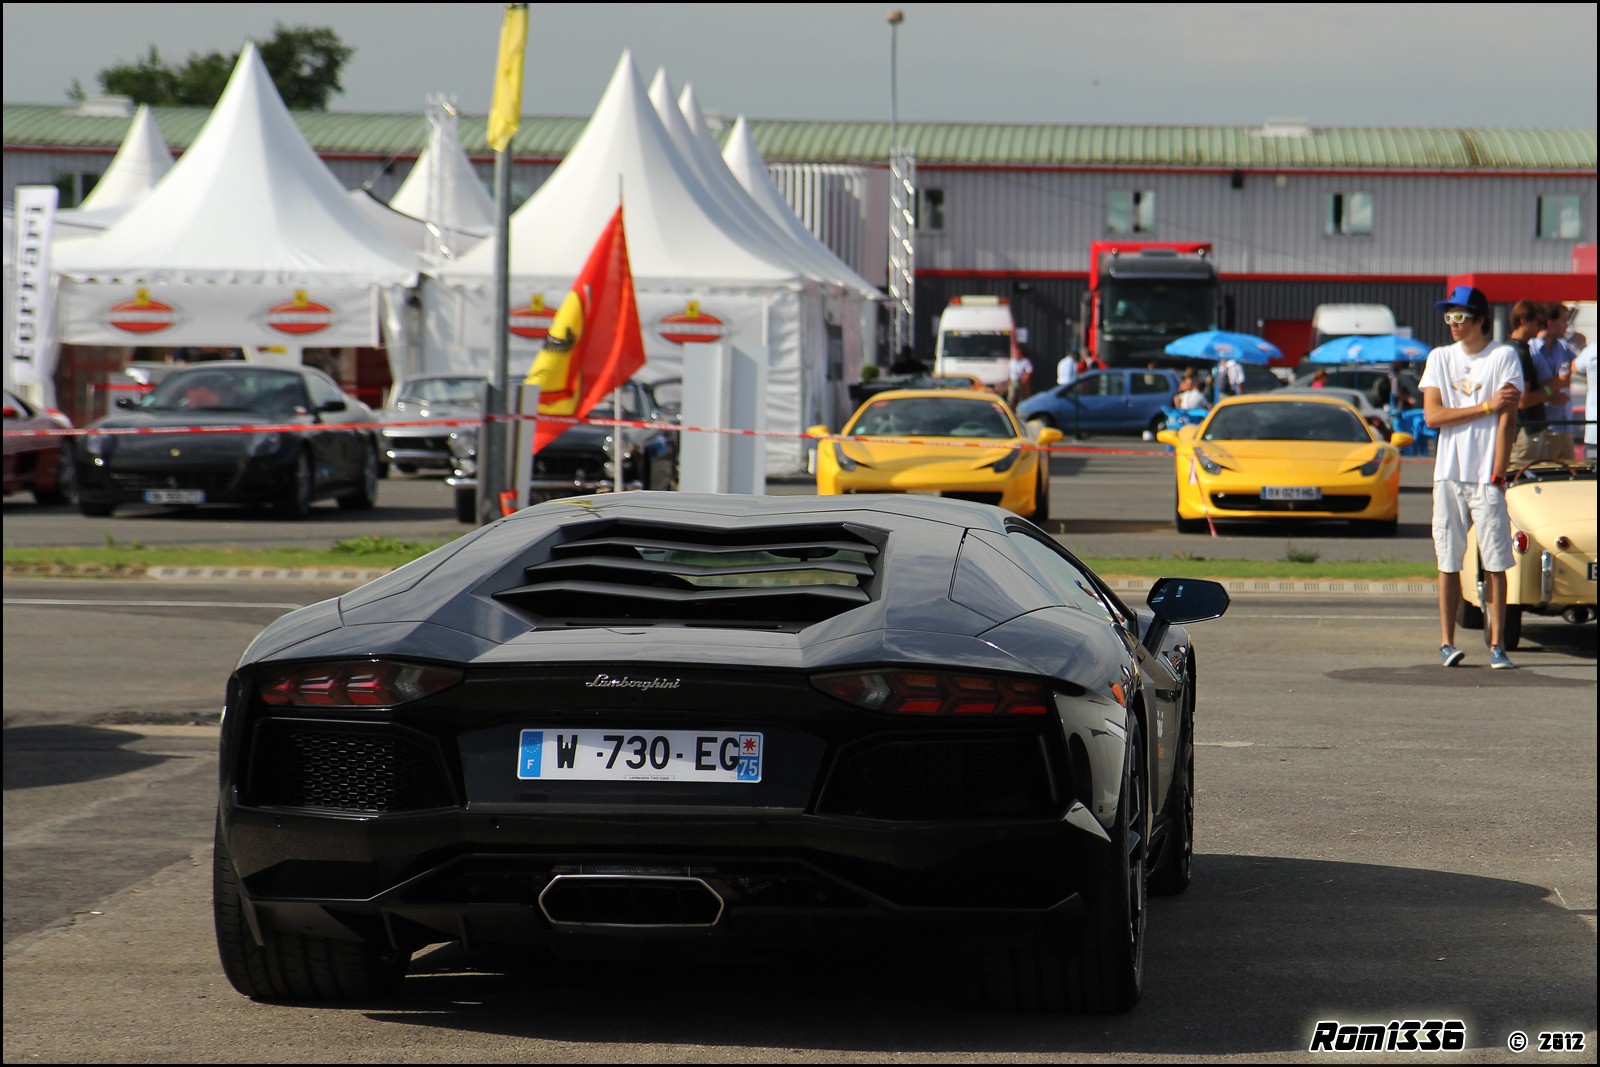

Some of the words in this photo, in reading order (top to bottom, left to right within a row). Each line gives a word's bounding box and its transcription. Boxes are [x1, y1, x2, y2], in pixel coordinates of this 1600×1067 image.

[13, 205, 43, 362] Ferrari
[585, 673, 681, 691] Lamborghini
[526, 759, 534, 770] F
[740, 759, 758, 777] 75
